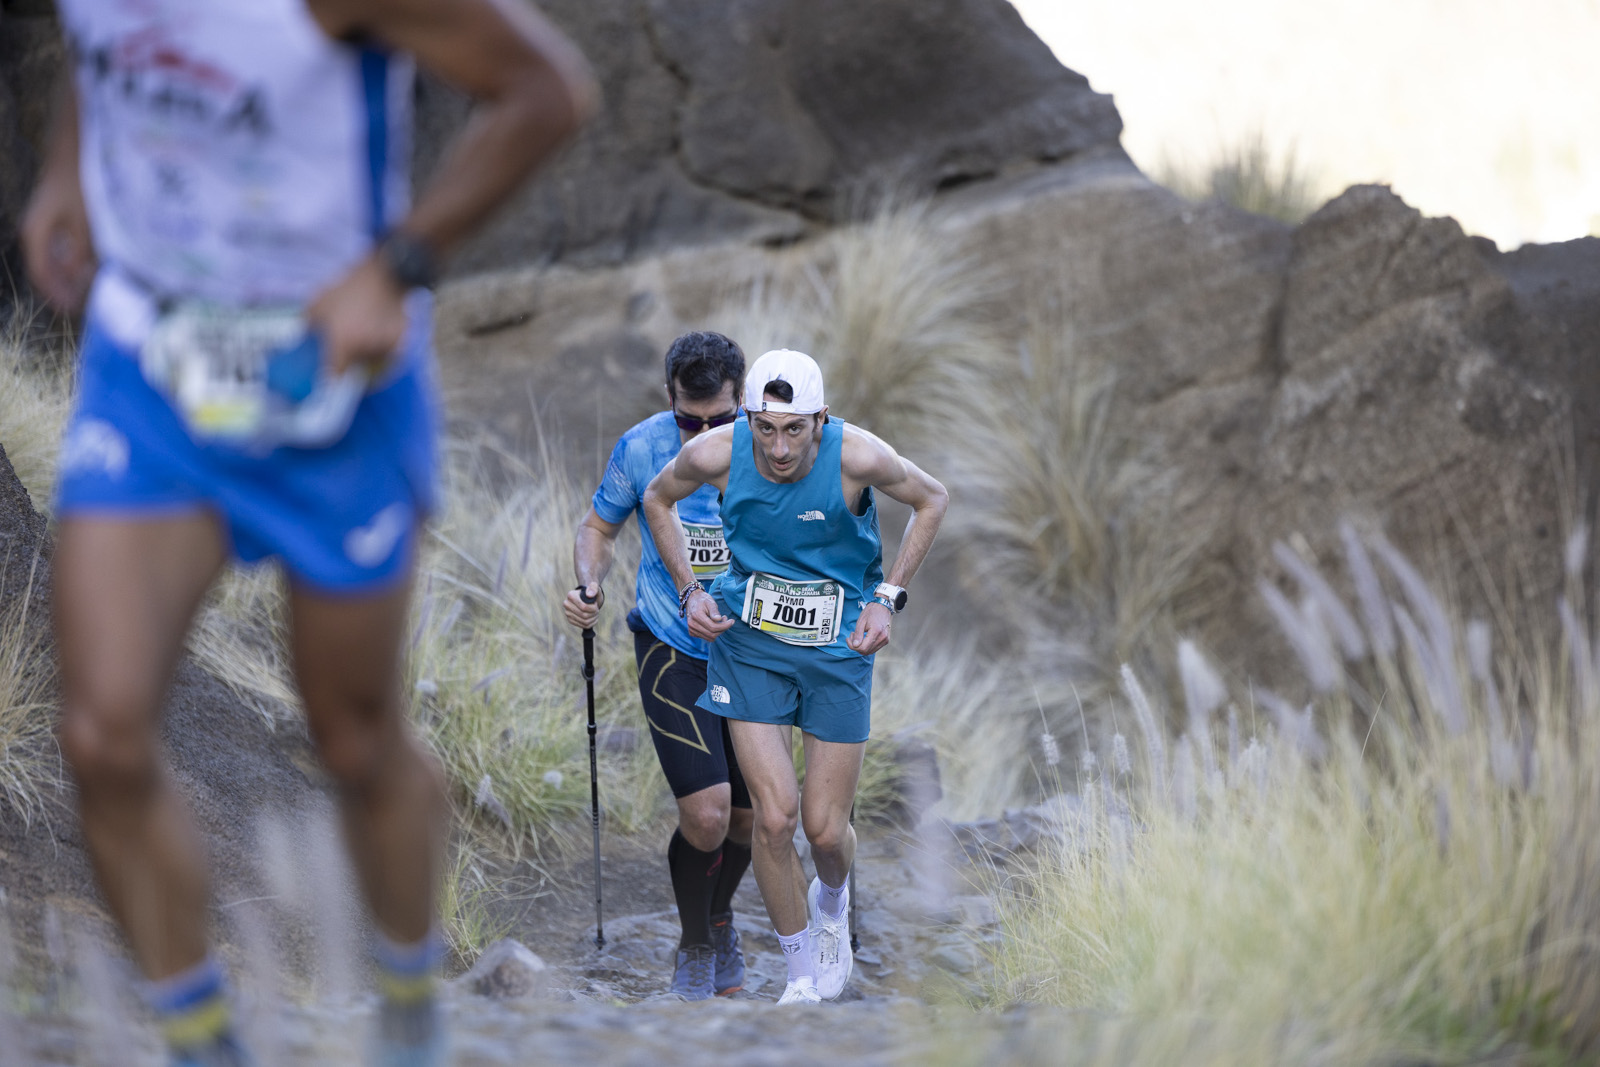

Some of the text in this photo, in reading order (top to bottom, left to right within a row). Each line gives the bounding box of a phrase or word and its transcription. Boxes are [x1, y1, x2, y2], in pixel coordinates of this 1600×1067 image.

[690, 539, 722, 547] ANDREY
[688, 547, 732, 563] 7027
[779, 595, 805, 606] AYMO
[772, 602, 816, 626] 7001
